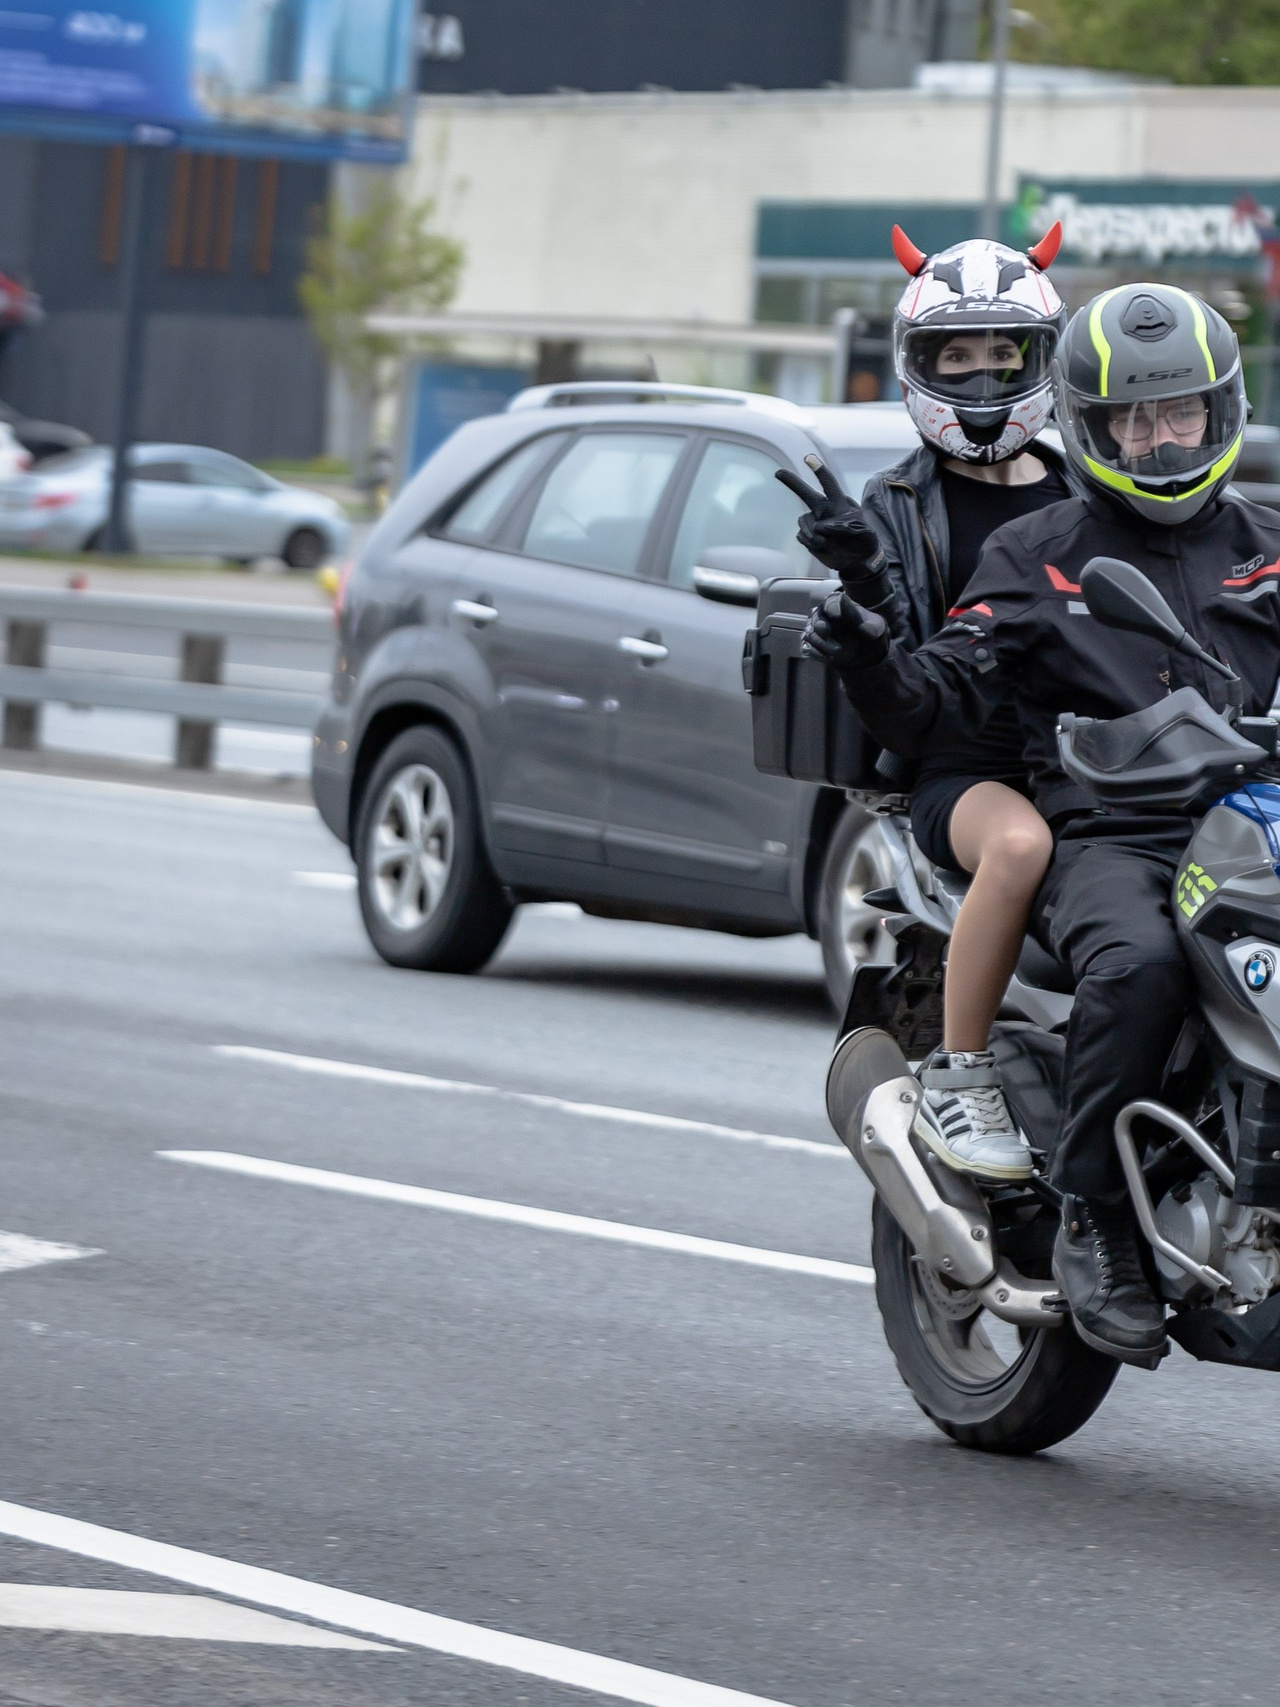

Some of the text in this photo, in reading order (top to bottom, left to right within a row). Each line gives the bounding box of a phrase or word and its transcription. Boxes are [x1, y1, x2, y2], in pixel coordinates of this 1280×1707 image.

[946, 301, 1014, 314] LS2
[1126, 367, 1194, 385] LS2
[1233, 555, 1264, 577] MCP
[1177, 862, 1219, 918] GS
